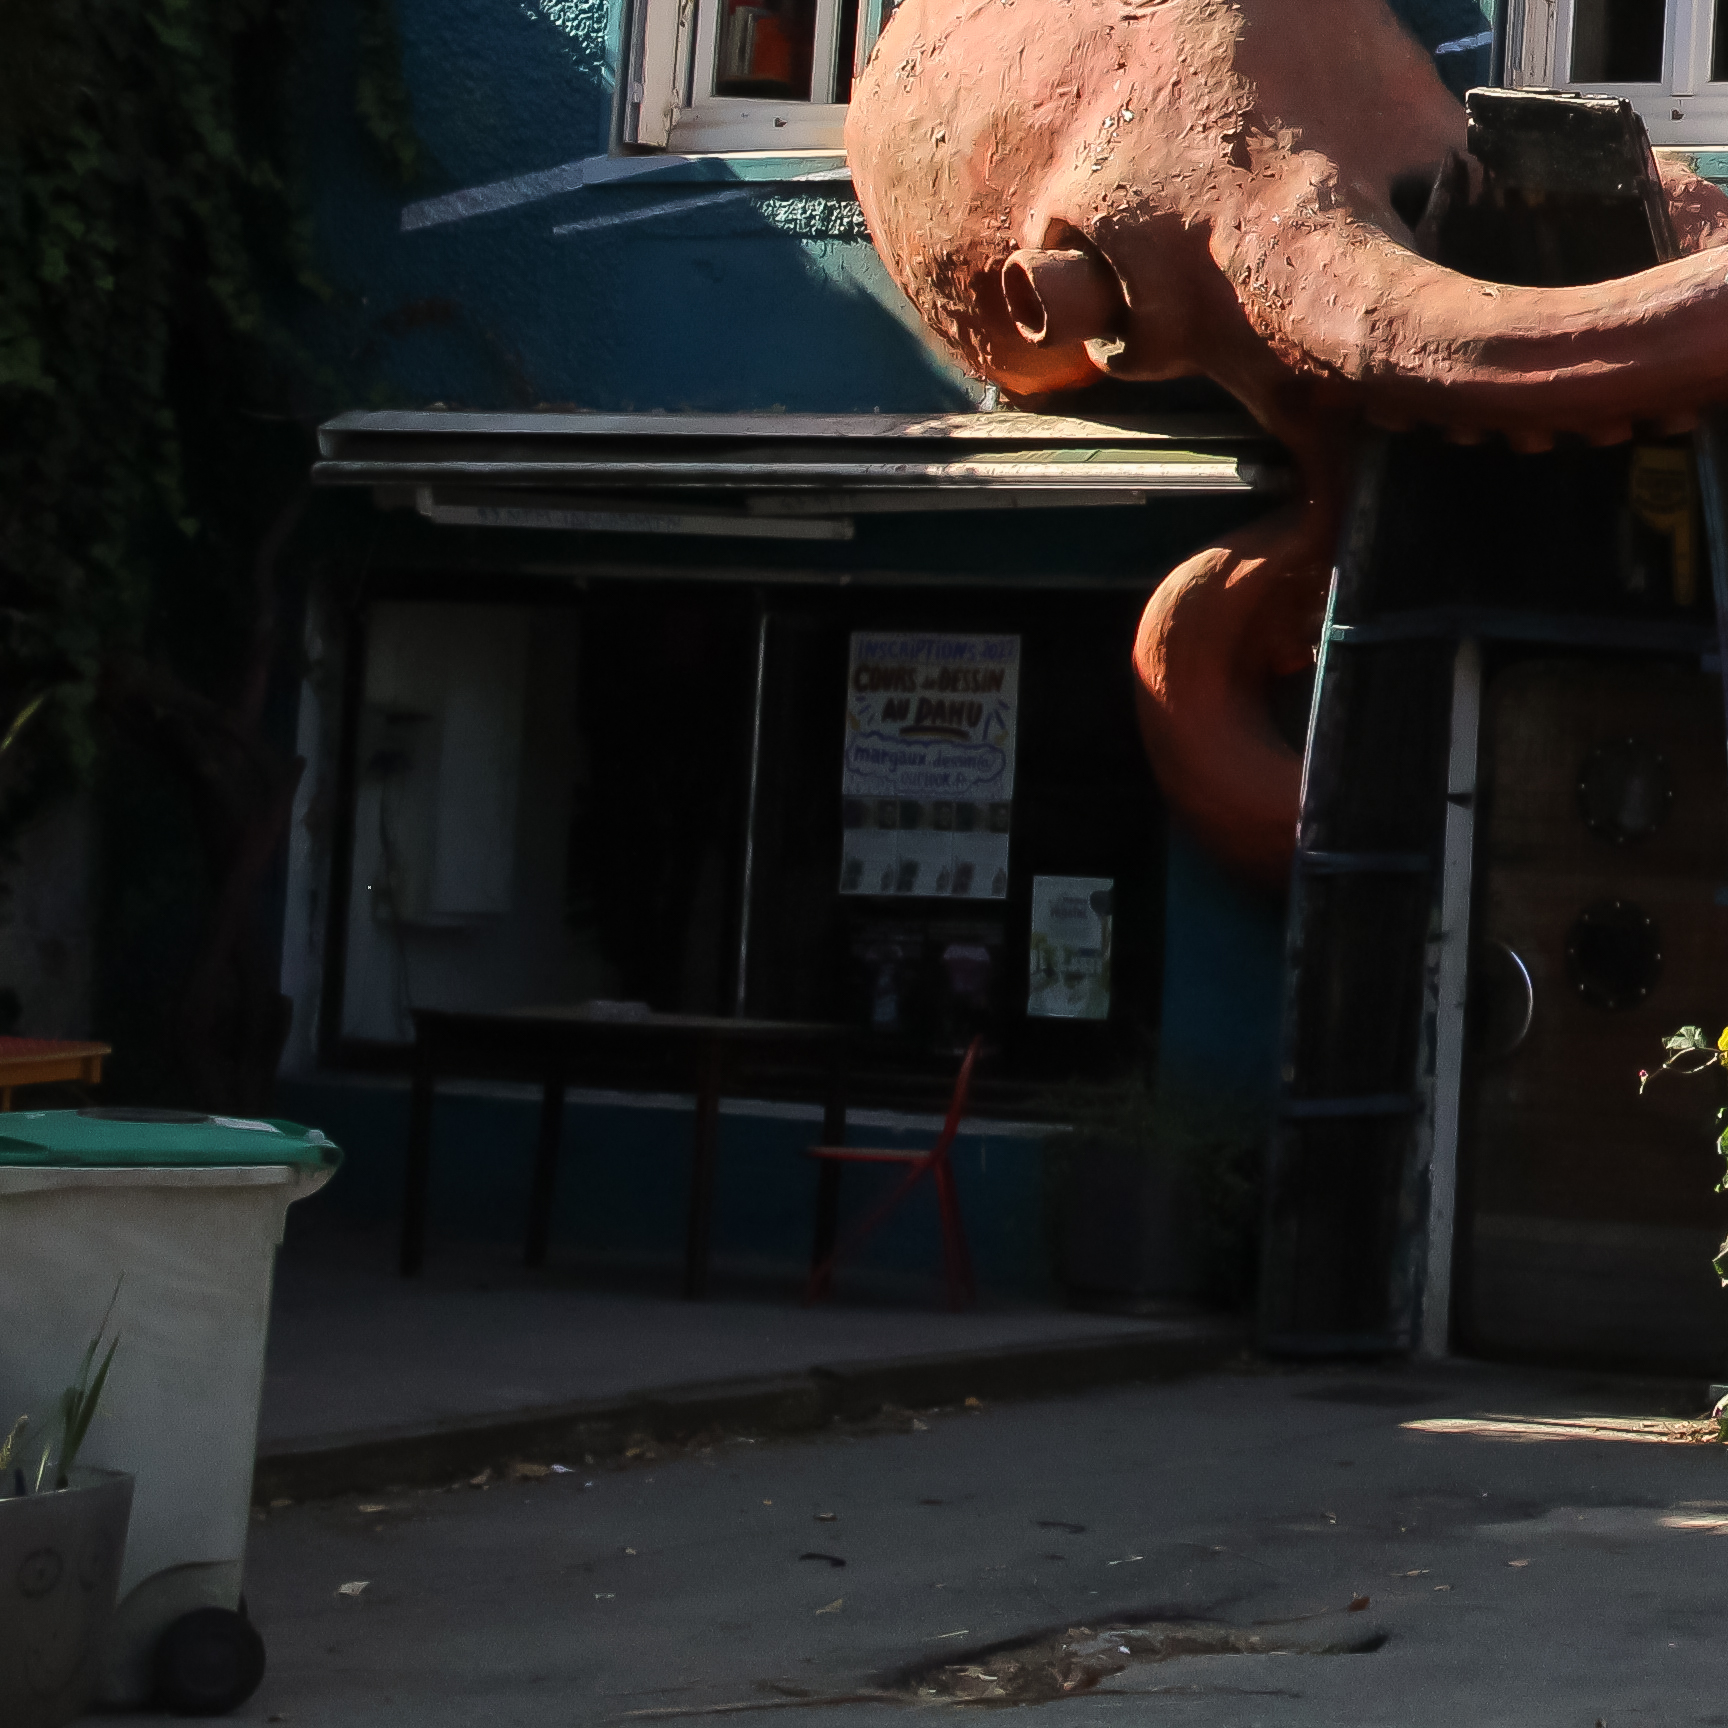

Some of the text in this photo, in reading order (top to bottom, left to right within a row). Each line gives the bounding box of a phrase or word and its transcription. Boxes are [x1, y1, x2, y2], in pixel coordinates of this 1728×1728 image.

[853, 662, 917, 693] COURS
[881, 695, 984, 728] AU DAHU
